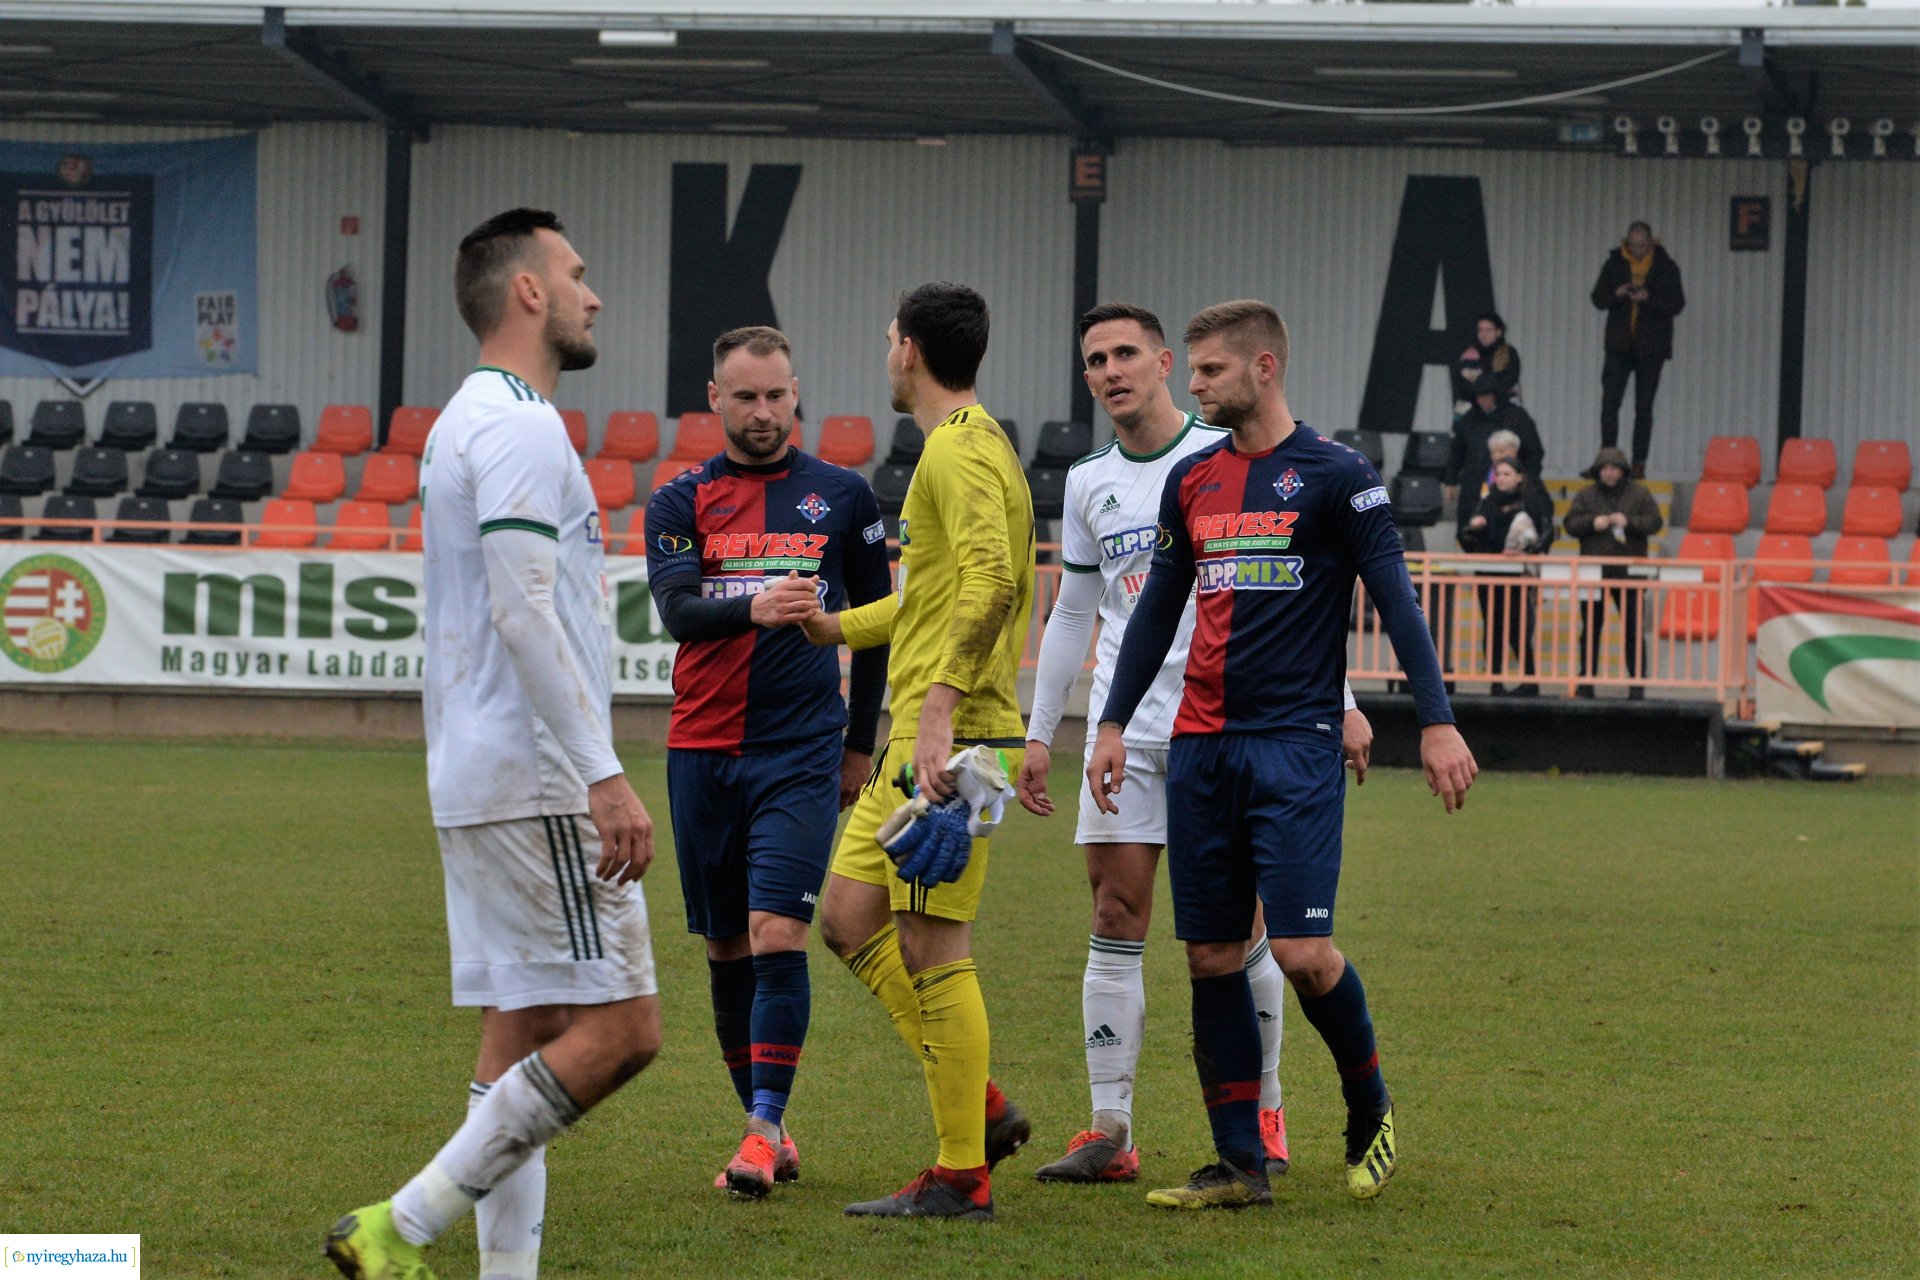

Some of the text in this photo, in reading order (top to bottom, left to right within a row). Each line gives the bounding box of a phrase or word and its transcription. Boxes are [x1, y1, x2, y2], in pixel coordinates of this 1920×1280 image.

[19, 200, 31, 222] A
[17, 225, 131, 283] NEM
[16, 283, 130, 330] PÁLYA!
[198, 295, 235, 310] FAIR
[162, 646, 289, 676] Magyar
[1305, 907, 1329, 919] JAKO
